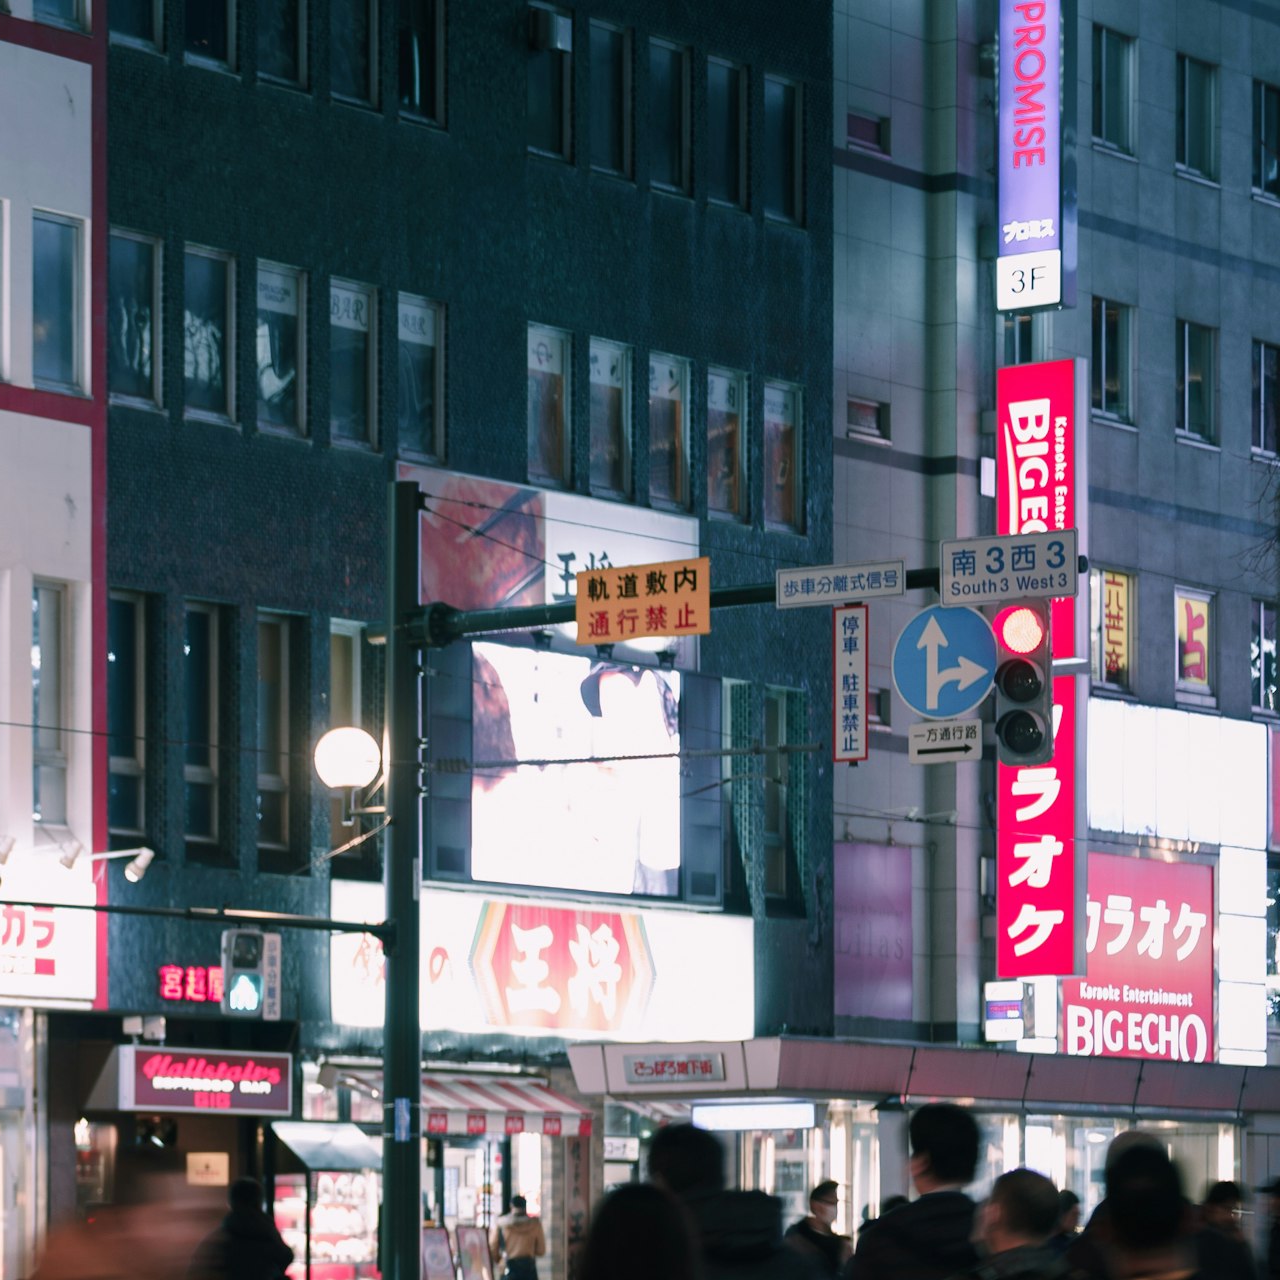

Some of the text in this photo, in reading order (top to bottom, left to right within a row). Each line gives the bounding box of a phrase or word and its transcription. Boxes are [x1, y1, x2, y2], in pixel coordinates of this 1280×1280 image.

[1013, 0, 1047, 169] PROMISE
[1003, 218, 1055, 244] プロミス
[1010, 265, 1048, 294] 3F
[330, 293, 367, 327] BAR
[1008, 398, 1051, 490] BIG
[1053, 416, 1068, 481] Karaoke
[587, 567, 698, 603] 軌道敷内
[783, 570, 900, 598] 歩車分離式信号
[951, 572, 1068, 596] South 3 West 3
[587, 602, 698, 638] 通行禁止
[841, 615, 860, 753] 停車・駐車禁止
[913, 724, 979, 743] 一方通行路
[1006, 703, 1065, 957] ラオケ
[1079, 981, 1194, 1008] Karaoke Entertainment
[1066, 1003, 1208, 1064] BIG ECHO
